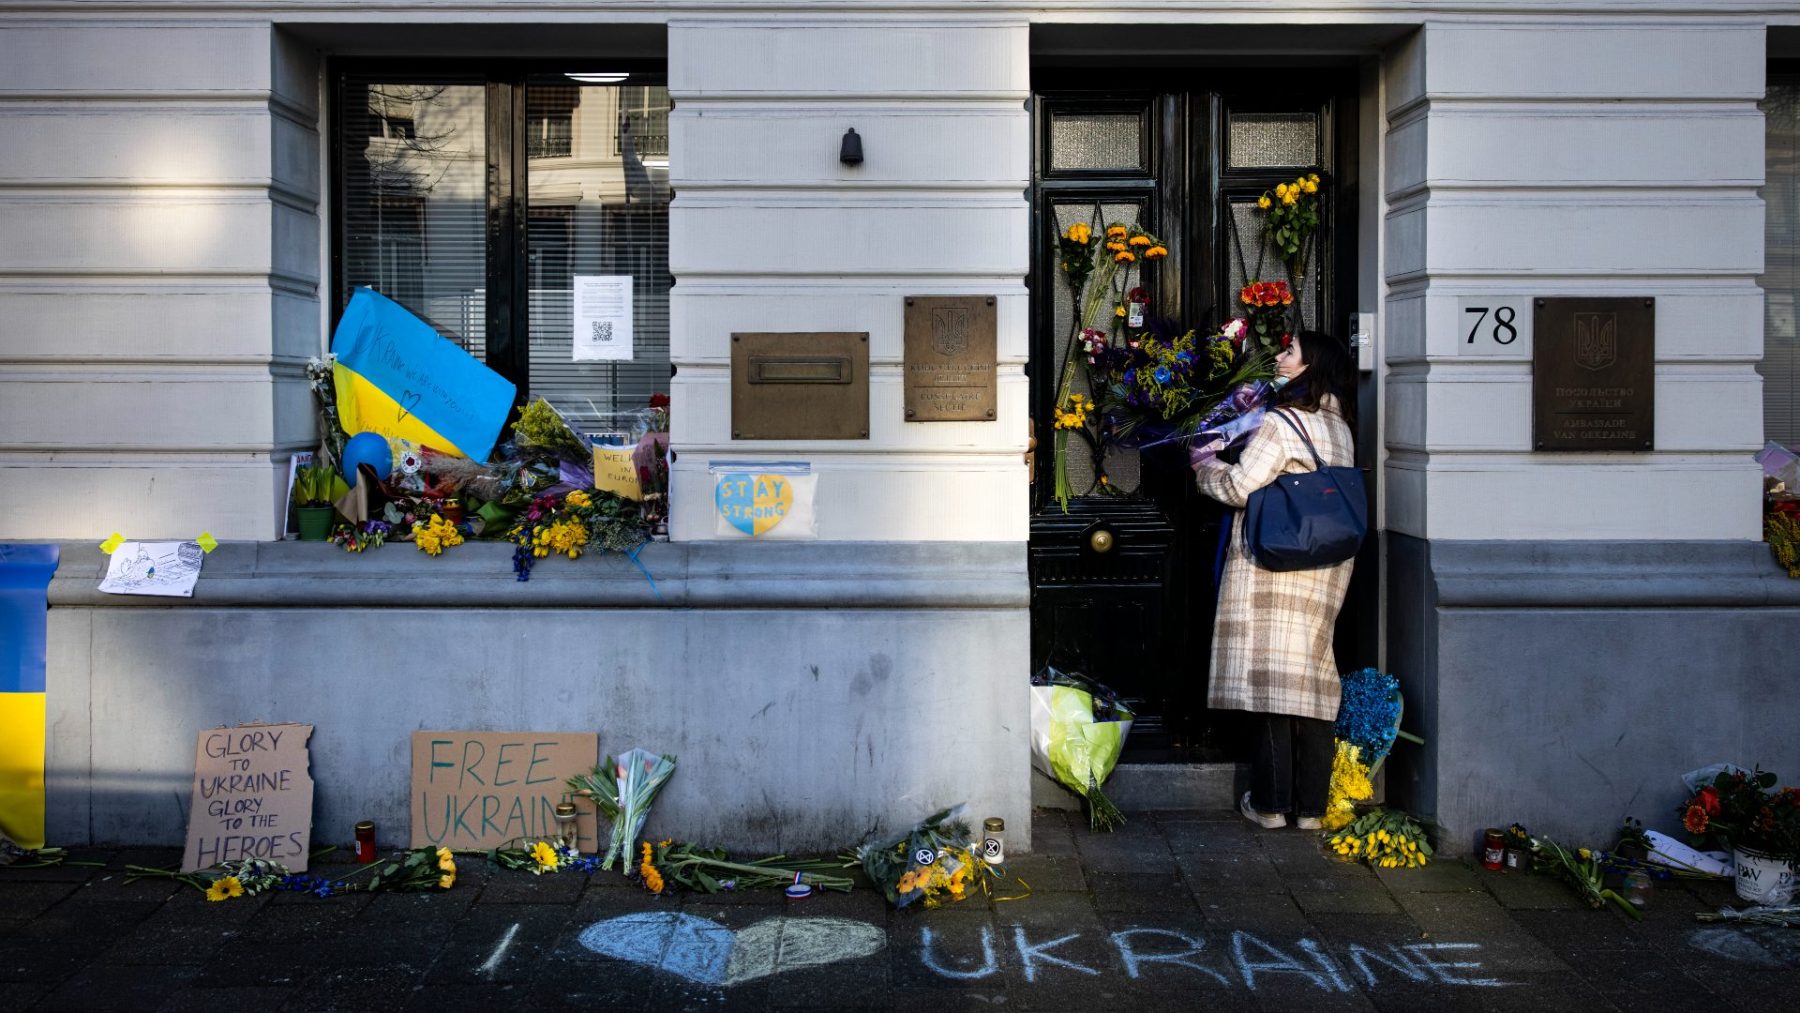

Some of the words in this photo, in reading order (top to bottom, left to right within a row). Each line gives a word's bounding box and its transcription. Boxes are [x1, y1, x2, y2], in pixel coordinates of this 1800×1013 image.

[1465, 306, 1517, 345] 78
[1553, 430, 1577, 439] VAN
[722, 481, 785, 498] STAY
[722, 502, 785, 519] STRONG
[205, 731, 283, 758] GLORY
[229, 758, 250, 771] TO
[430, 740, 560, 790] FREE
[200, 770, 292, 799] UKRAINE
[208, 797, 263, 817] GLORY
[219, 818, 243, 830] TO
[249, 814, 279, 828] THE
[197, 831, 303, 868] HEROES
[921, 922, 1505, 992] UKRAINE
